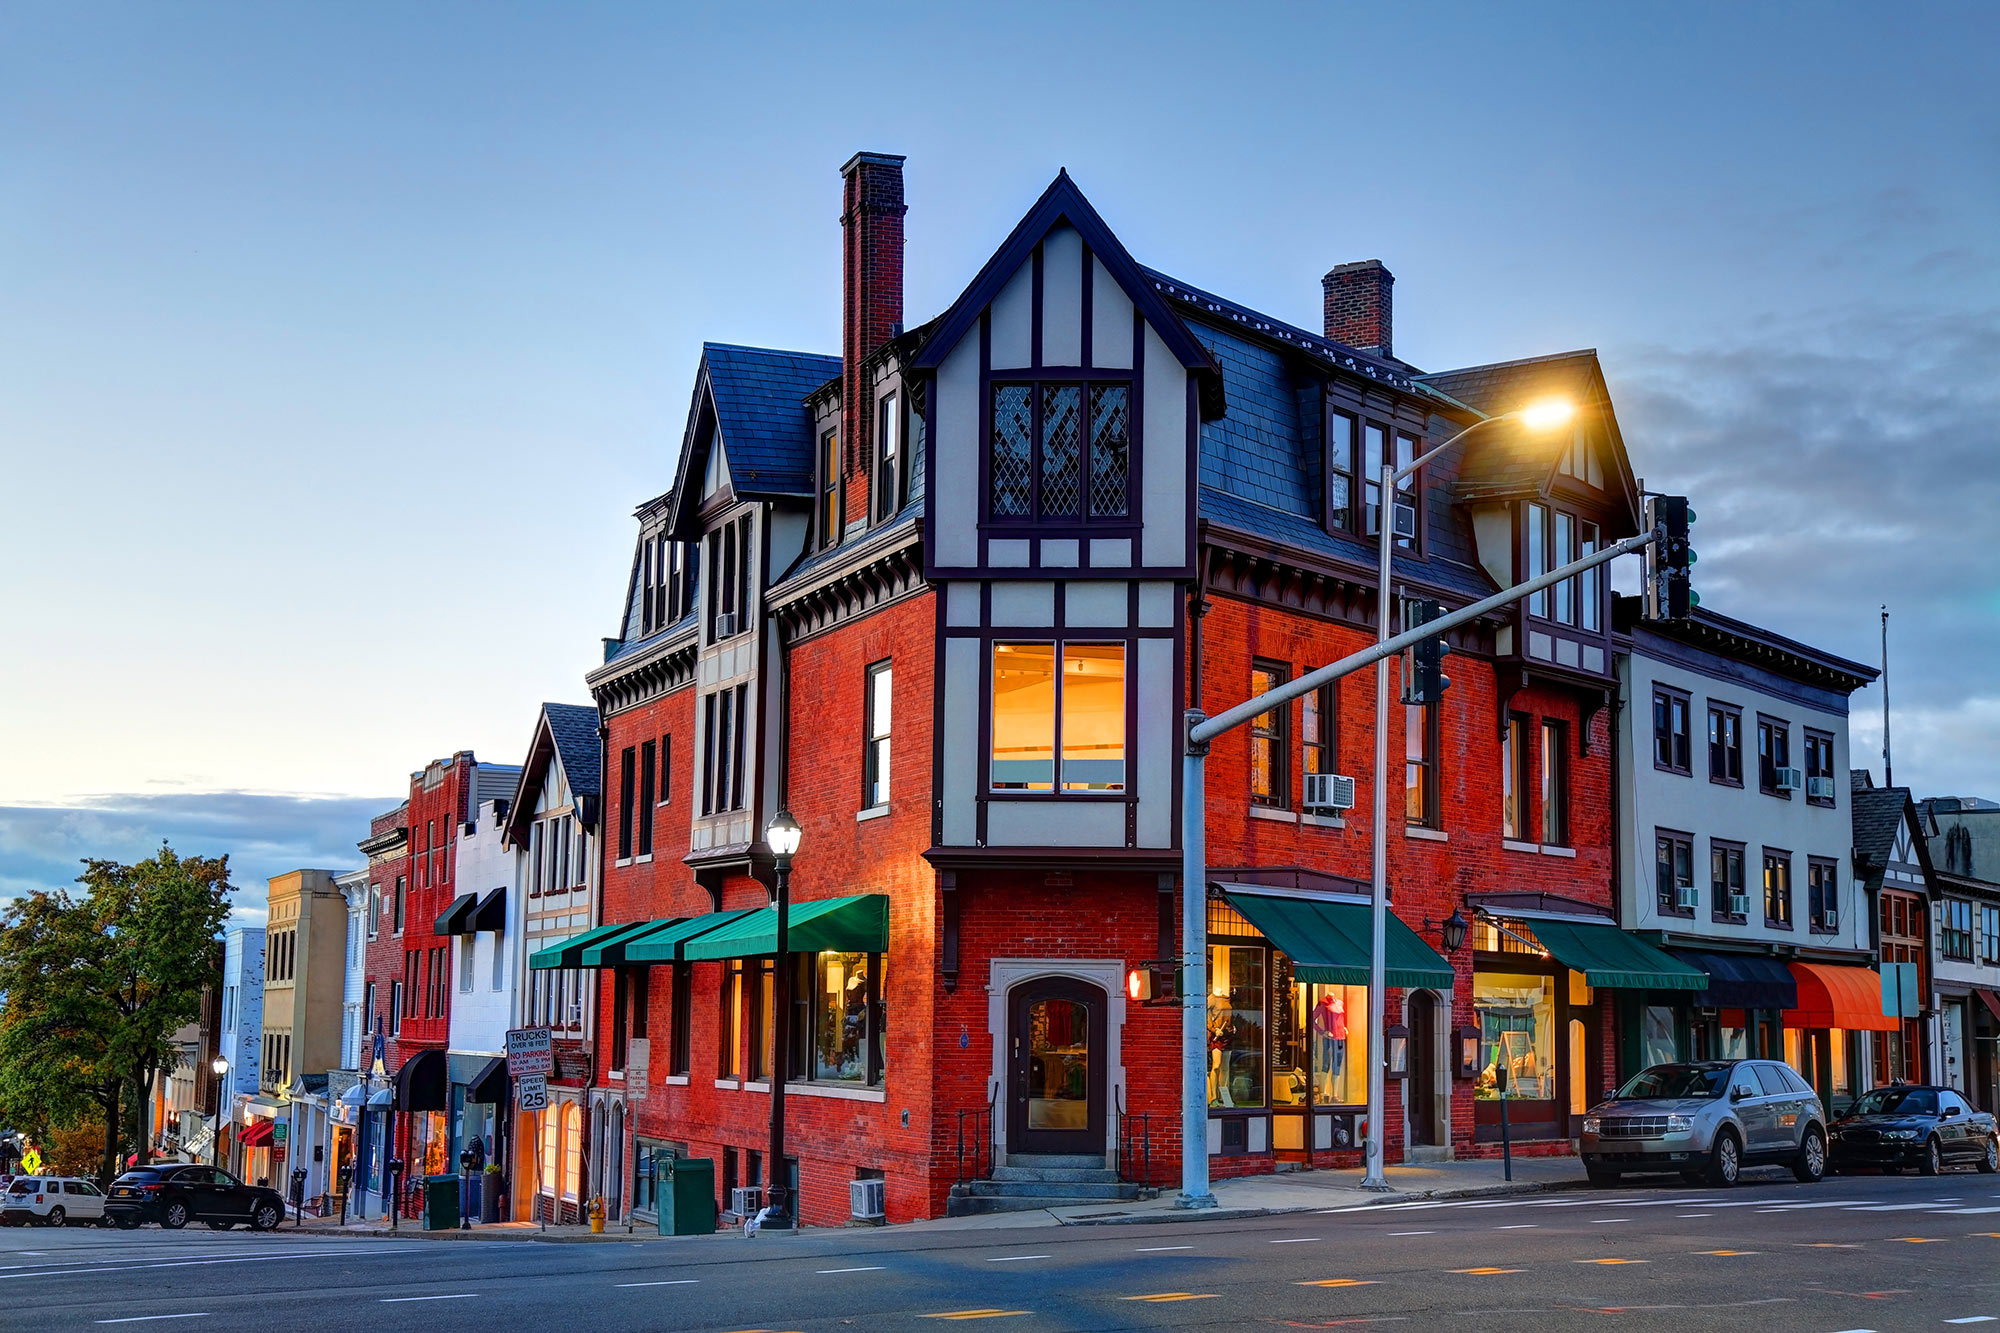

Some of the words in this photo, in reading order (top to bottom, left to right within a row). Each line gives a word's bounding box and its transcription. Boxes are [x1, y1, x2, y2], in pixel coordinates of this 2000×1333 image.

[511, 1030, 548, 1042] TRUCKS
[511, 1041, 527, 1049] OVER
[528, 1040, 534, 1048] 18
[510, 1052, 521, 1060] NO
[522, 1049, 551, 1059] PARKING
[521, 1077, 544, 1085] SPEED
[523, 1092, 545, 1107] 25
